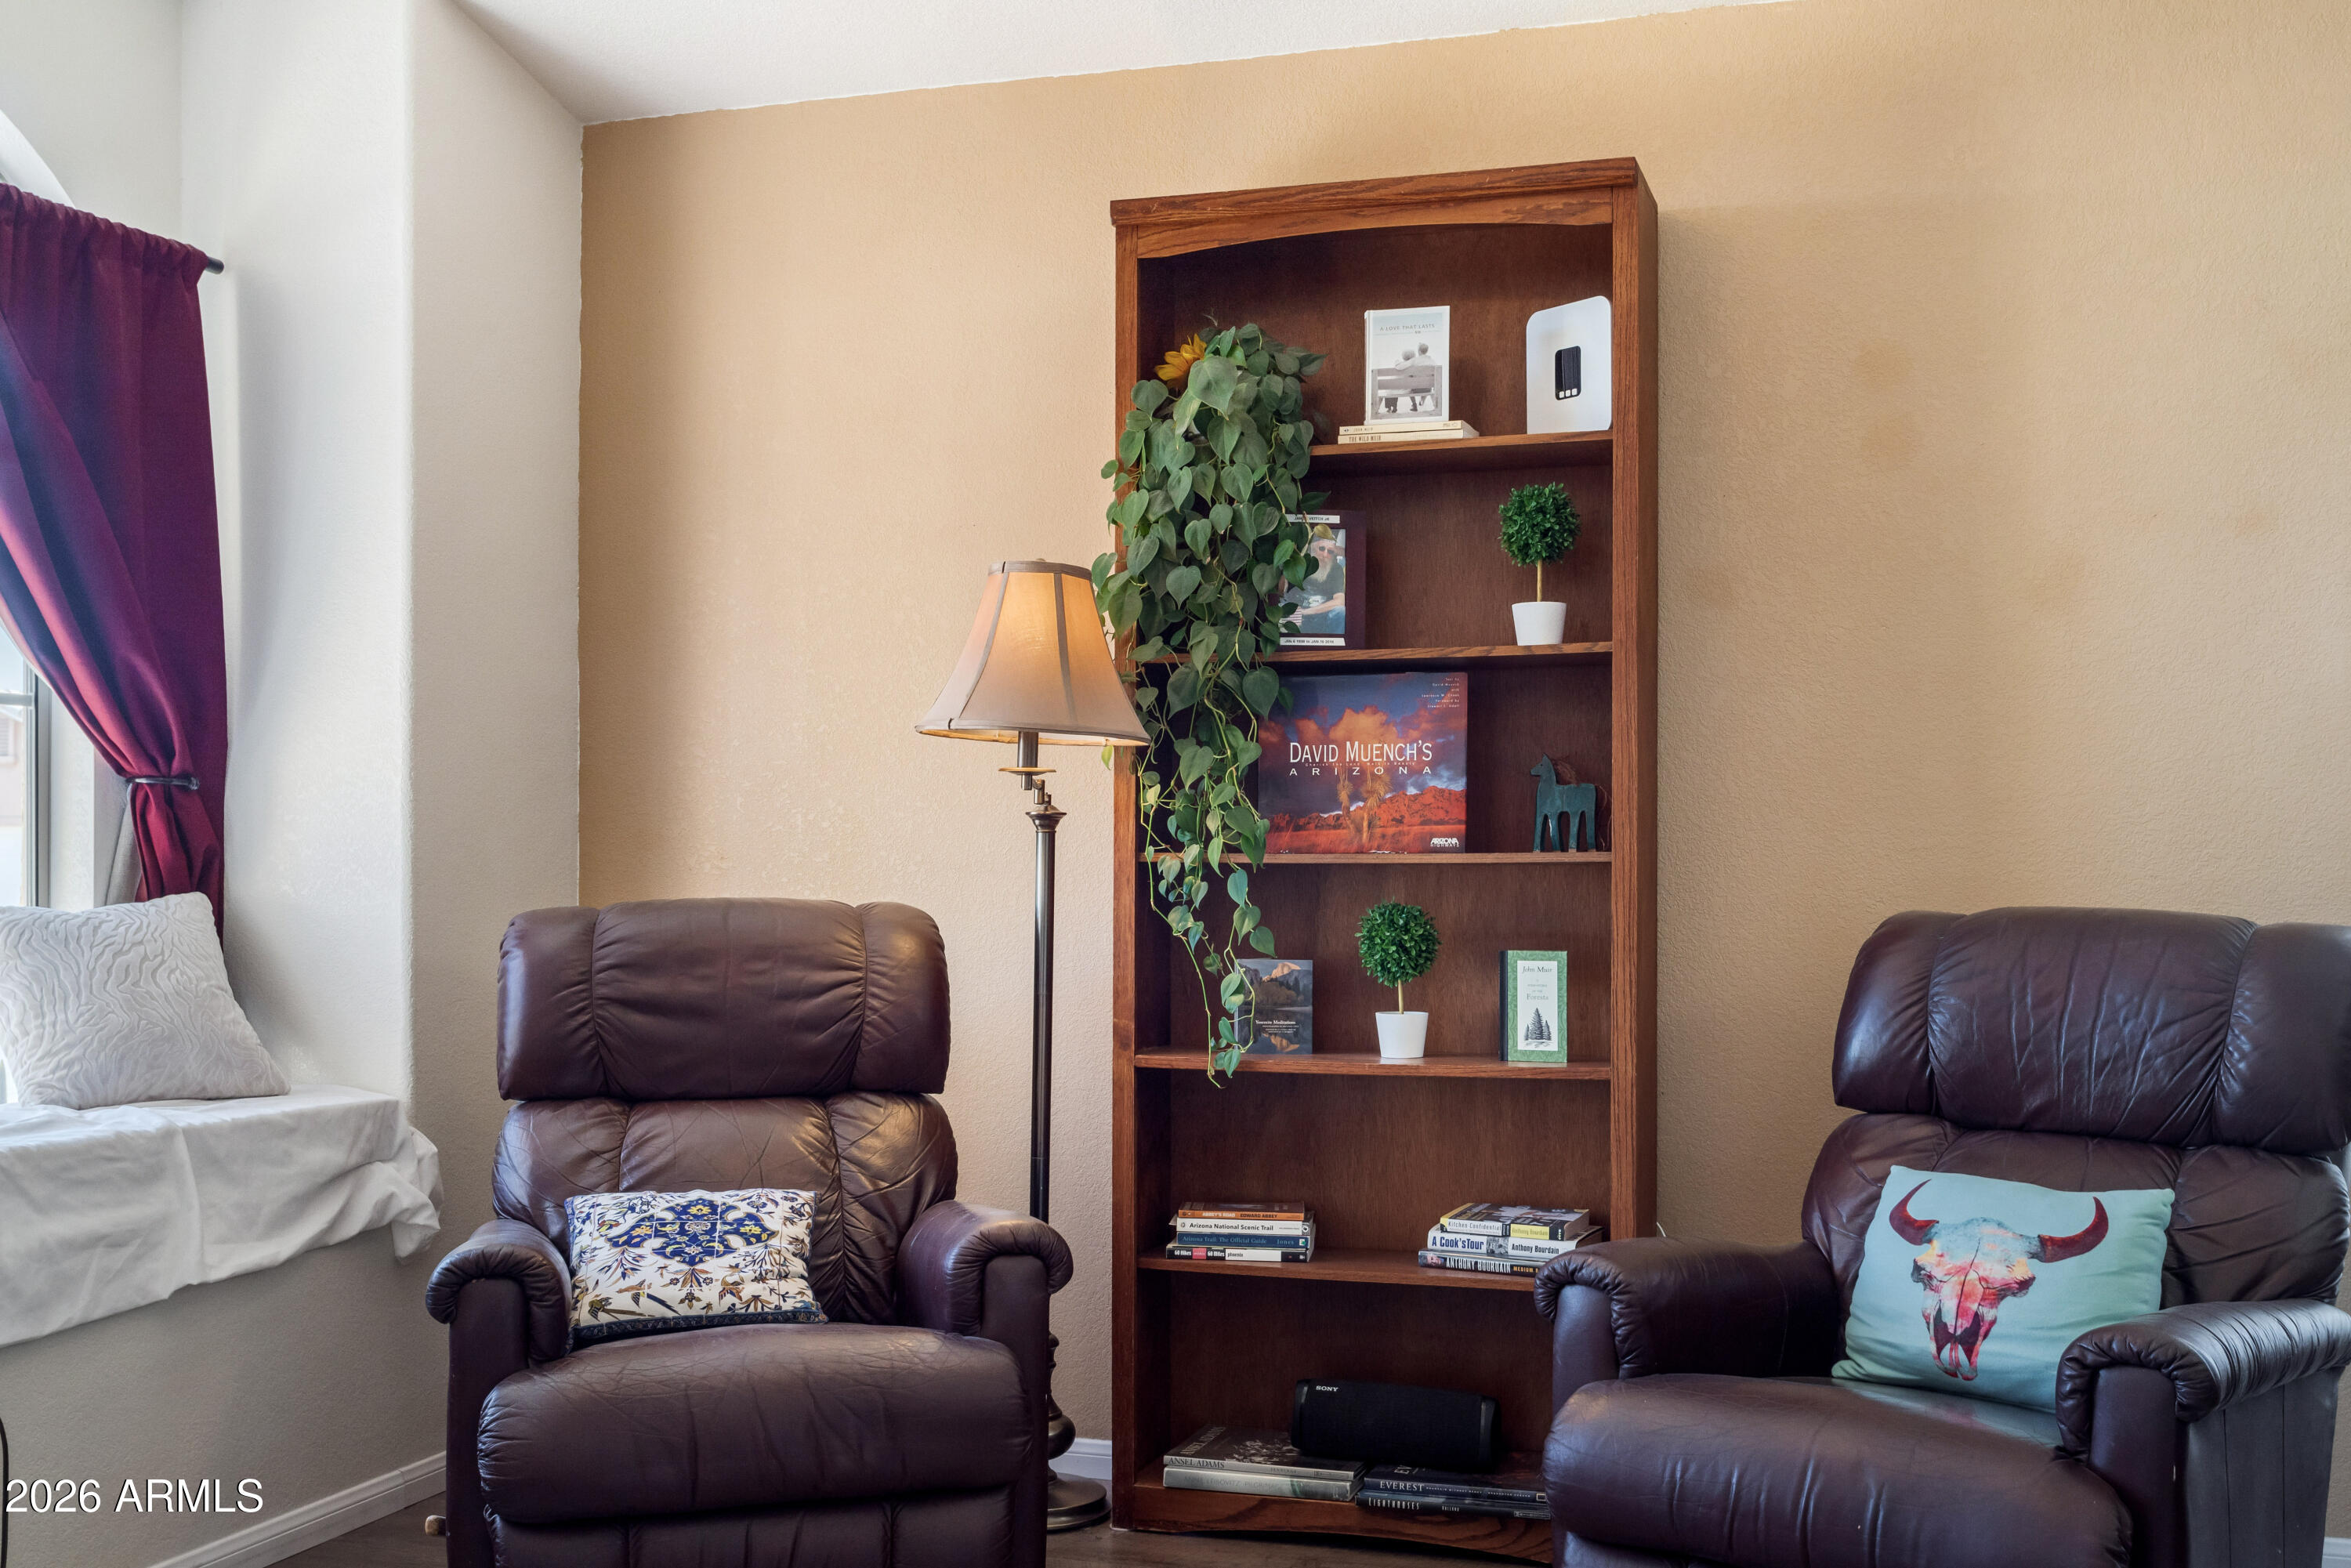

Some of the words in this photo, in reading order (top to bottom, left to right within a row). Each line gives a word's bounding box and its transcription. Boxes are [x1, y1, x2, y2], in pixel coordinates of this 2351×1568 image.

[1289, 766, 1432, 776] ARIZONA
[1512, 1227, 1530, 1236] Anthony
[1432, 1236, 1436, 1246] A
[1511, 1243, 1533, 1253] Anthony
[1534, 1245, 1559, 1254] Bourdain
[1446, 1257, 1474, 1269] ANTHONY
[1477, 1260, 1511, 1273] BOURDAIN
[1197, 1460, 1225, 1468] ADAMS
[1380, 1481, 1425, 1491] EVEREST
[1368, 1497, 1419, 1509] LIGHTHOUSES
